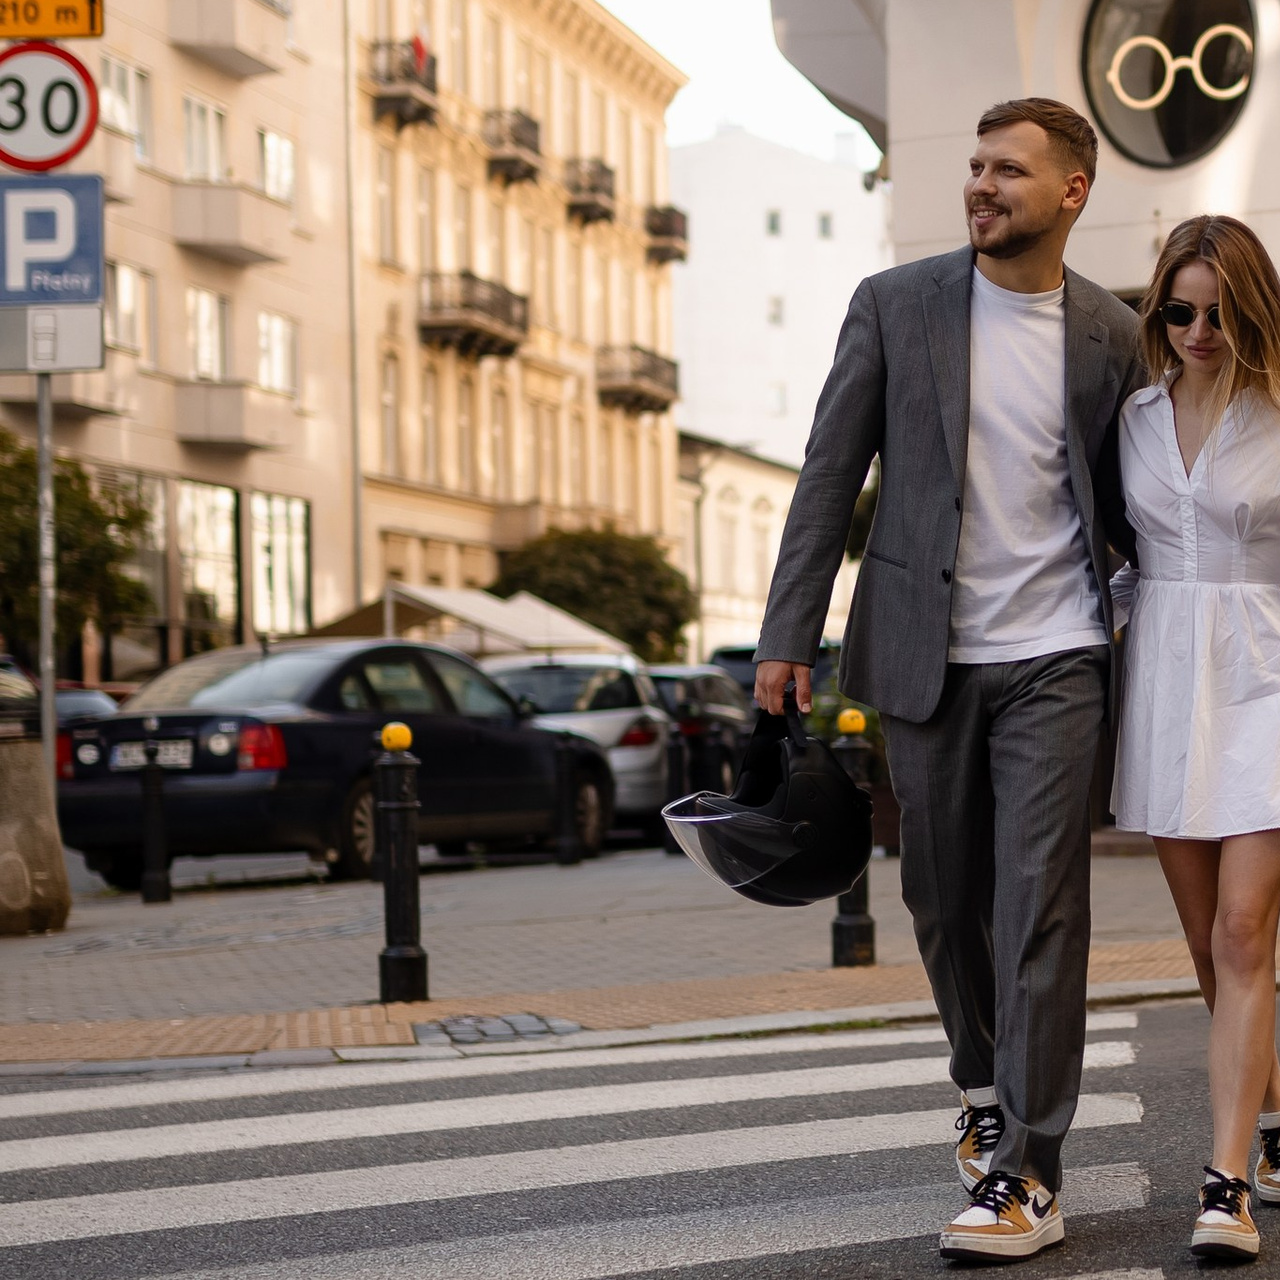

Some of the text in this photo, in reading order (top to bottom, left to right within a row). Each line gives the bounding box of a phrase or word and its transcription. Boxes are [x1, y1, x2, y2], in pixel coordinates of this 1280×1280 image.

[55, 5, 78, 24] m
[0, 77, 79, 135] 30
[5, 189, 76, 291] P
